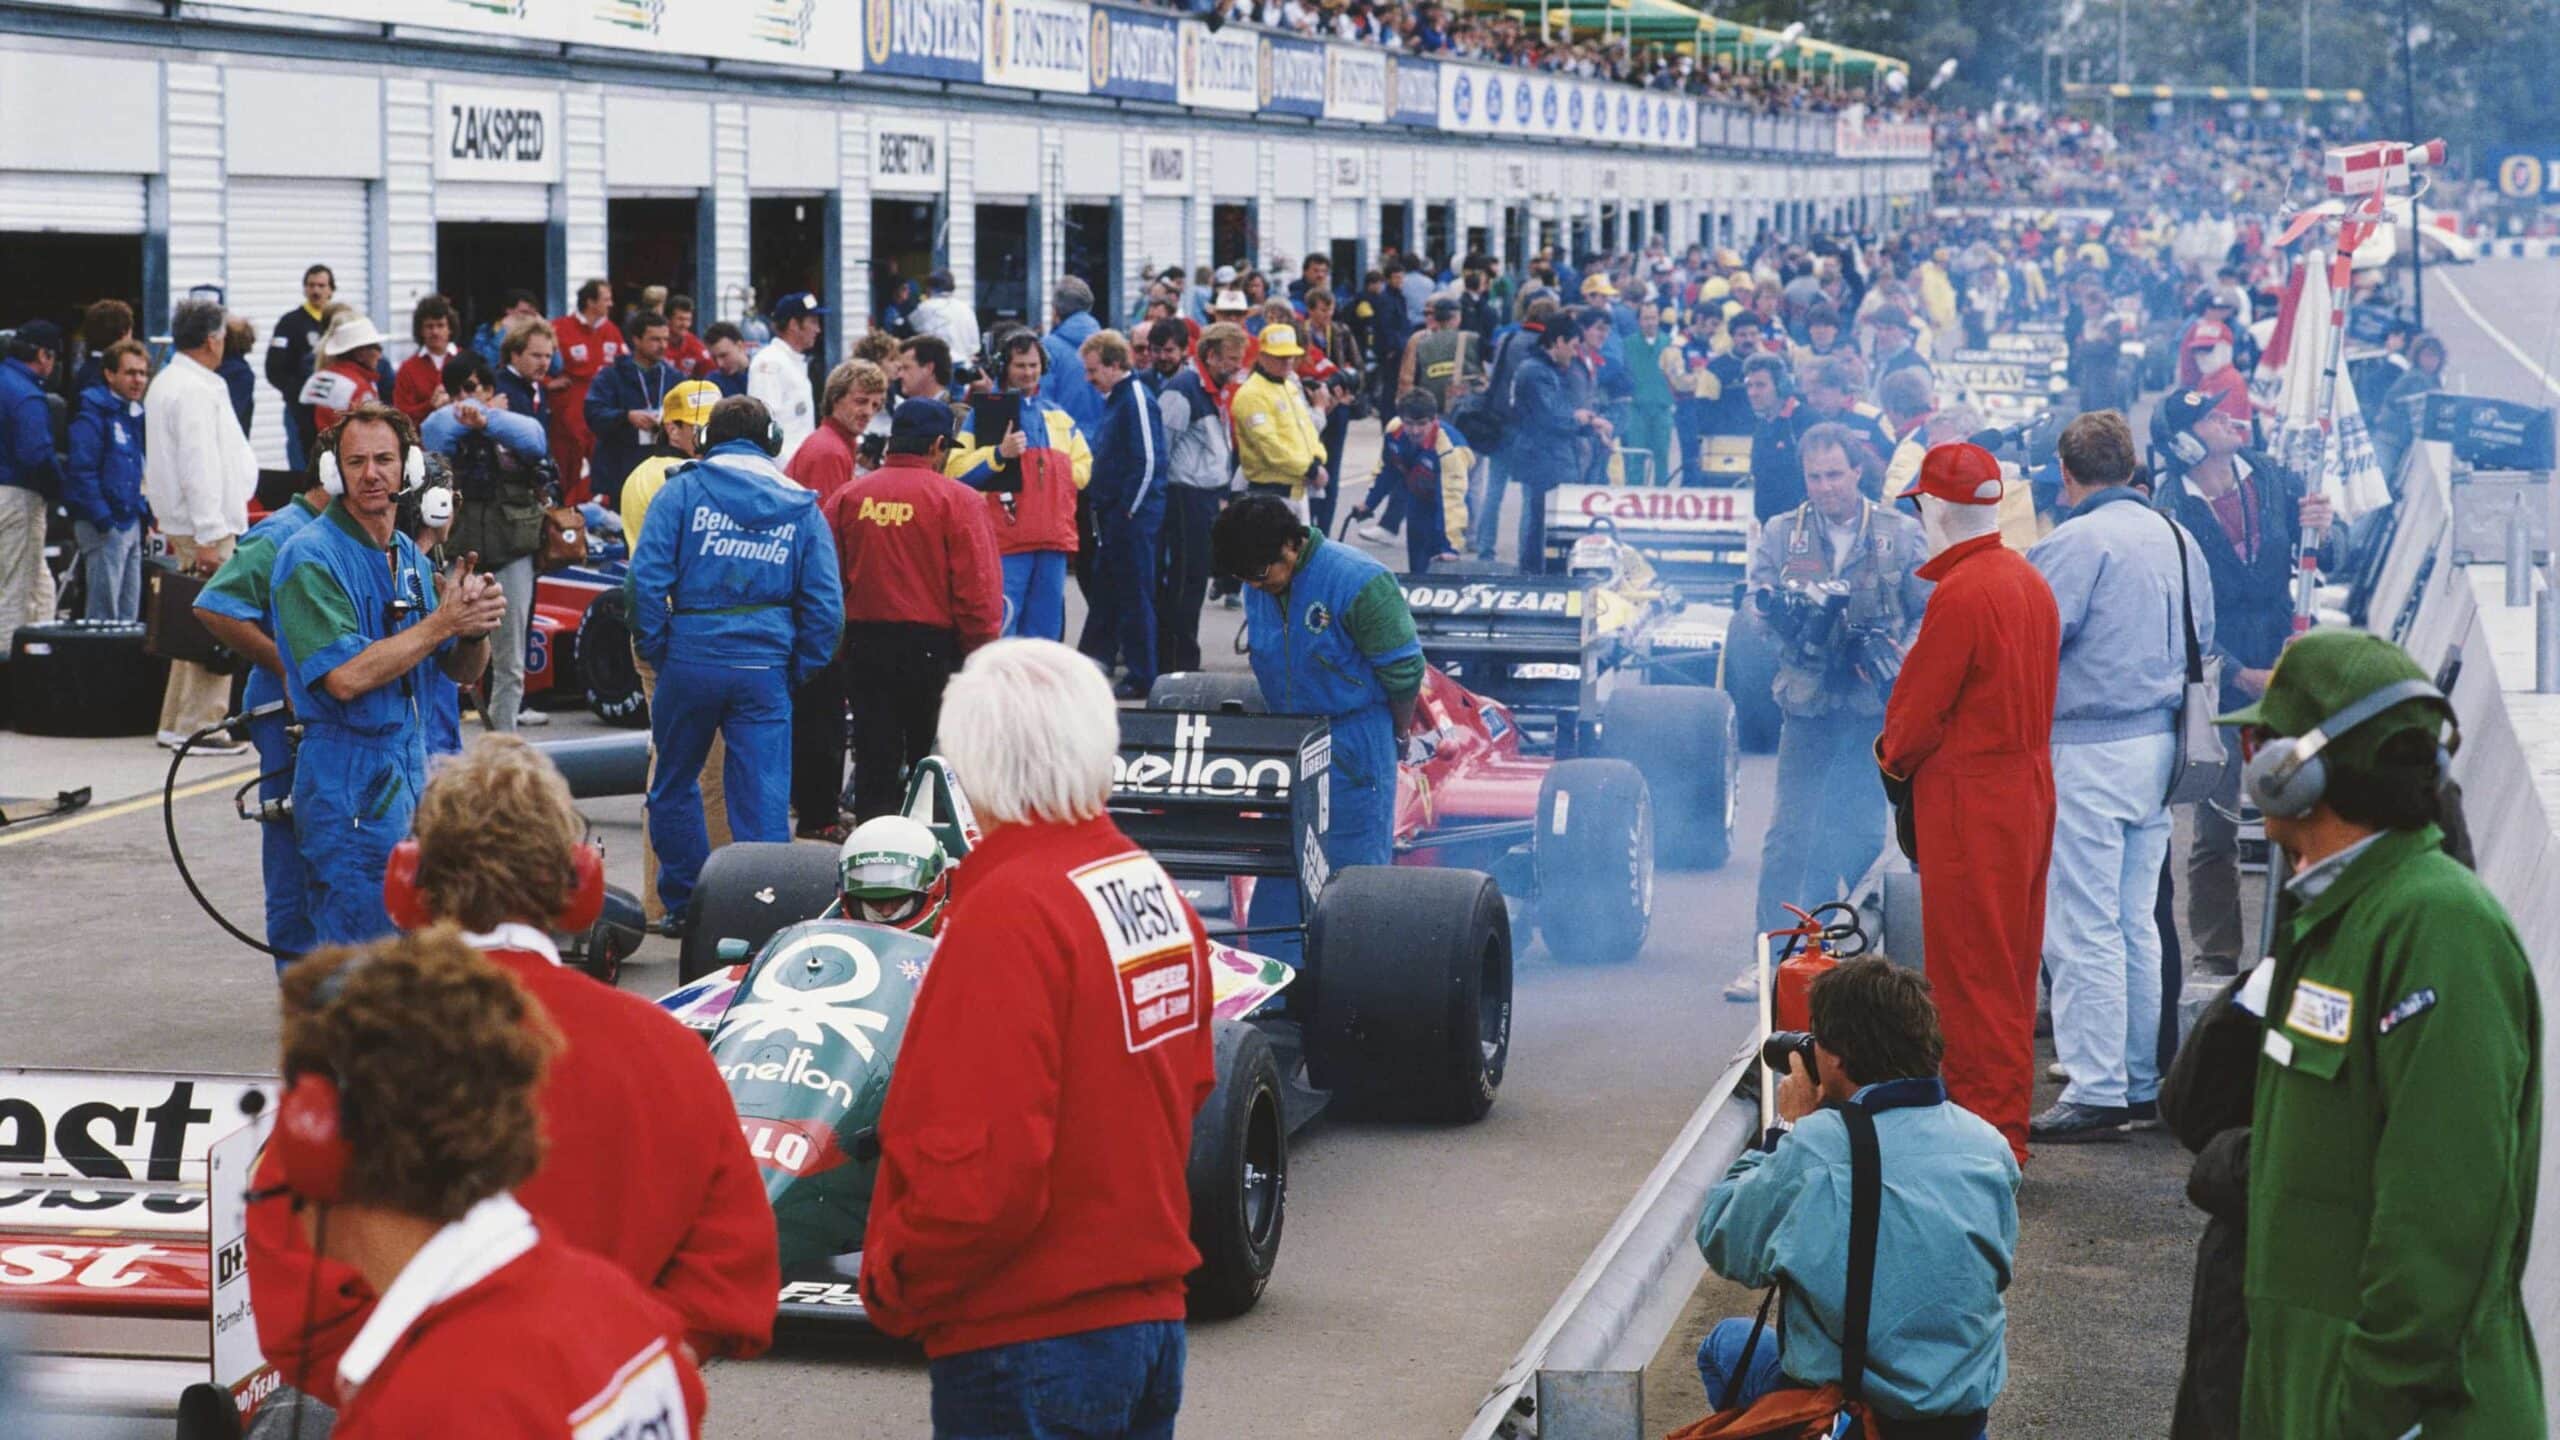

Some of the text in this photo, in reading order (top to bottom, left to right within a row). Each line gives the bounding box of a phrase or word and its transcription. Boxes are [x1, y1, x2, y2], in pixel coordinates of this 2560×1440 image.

[452, 105, 544, 161] ZAKSPEED
[880, 132, 935, 174] BENETTON
[858, 496, 914, 526] Agip
[1582, 491, 1735, 522] Canon
[699, 531, 789, 565] Formula
[1096, 879, 1180, 945] West
[0, 1081, 212, 1214] est
